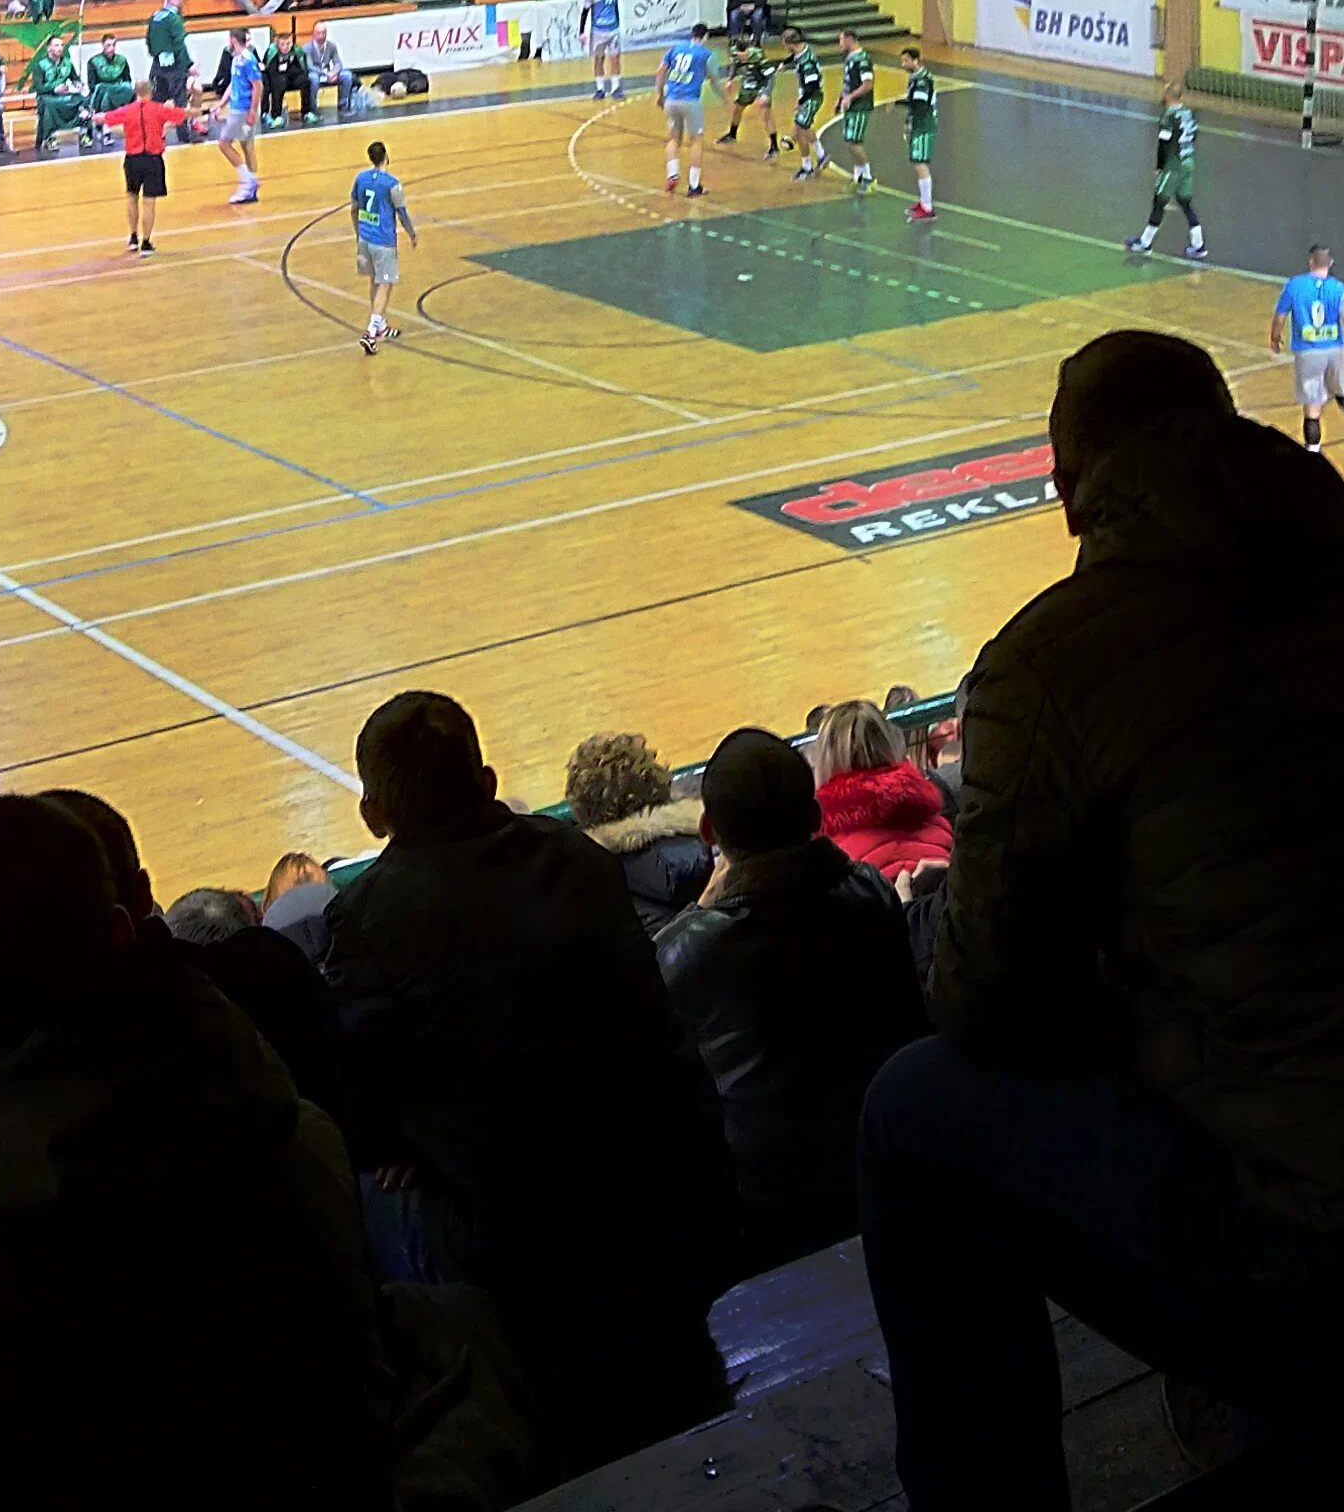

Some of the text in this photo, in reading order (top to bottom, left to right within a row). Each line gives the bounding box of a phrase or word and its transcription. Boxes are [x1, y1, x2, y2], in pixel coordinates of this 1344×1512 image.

[397, 23, 482, 55] REMIX
[1034, 8, 1130, 47] BH POŠTA
[849, 480, 1058, 543] REKL
